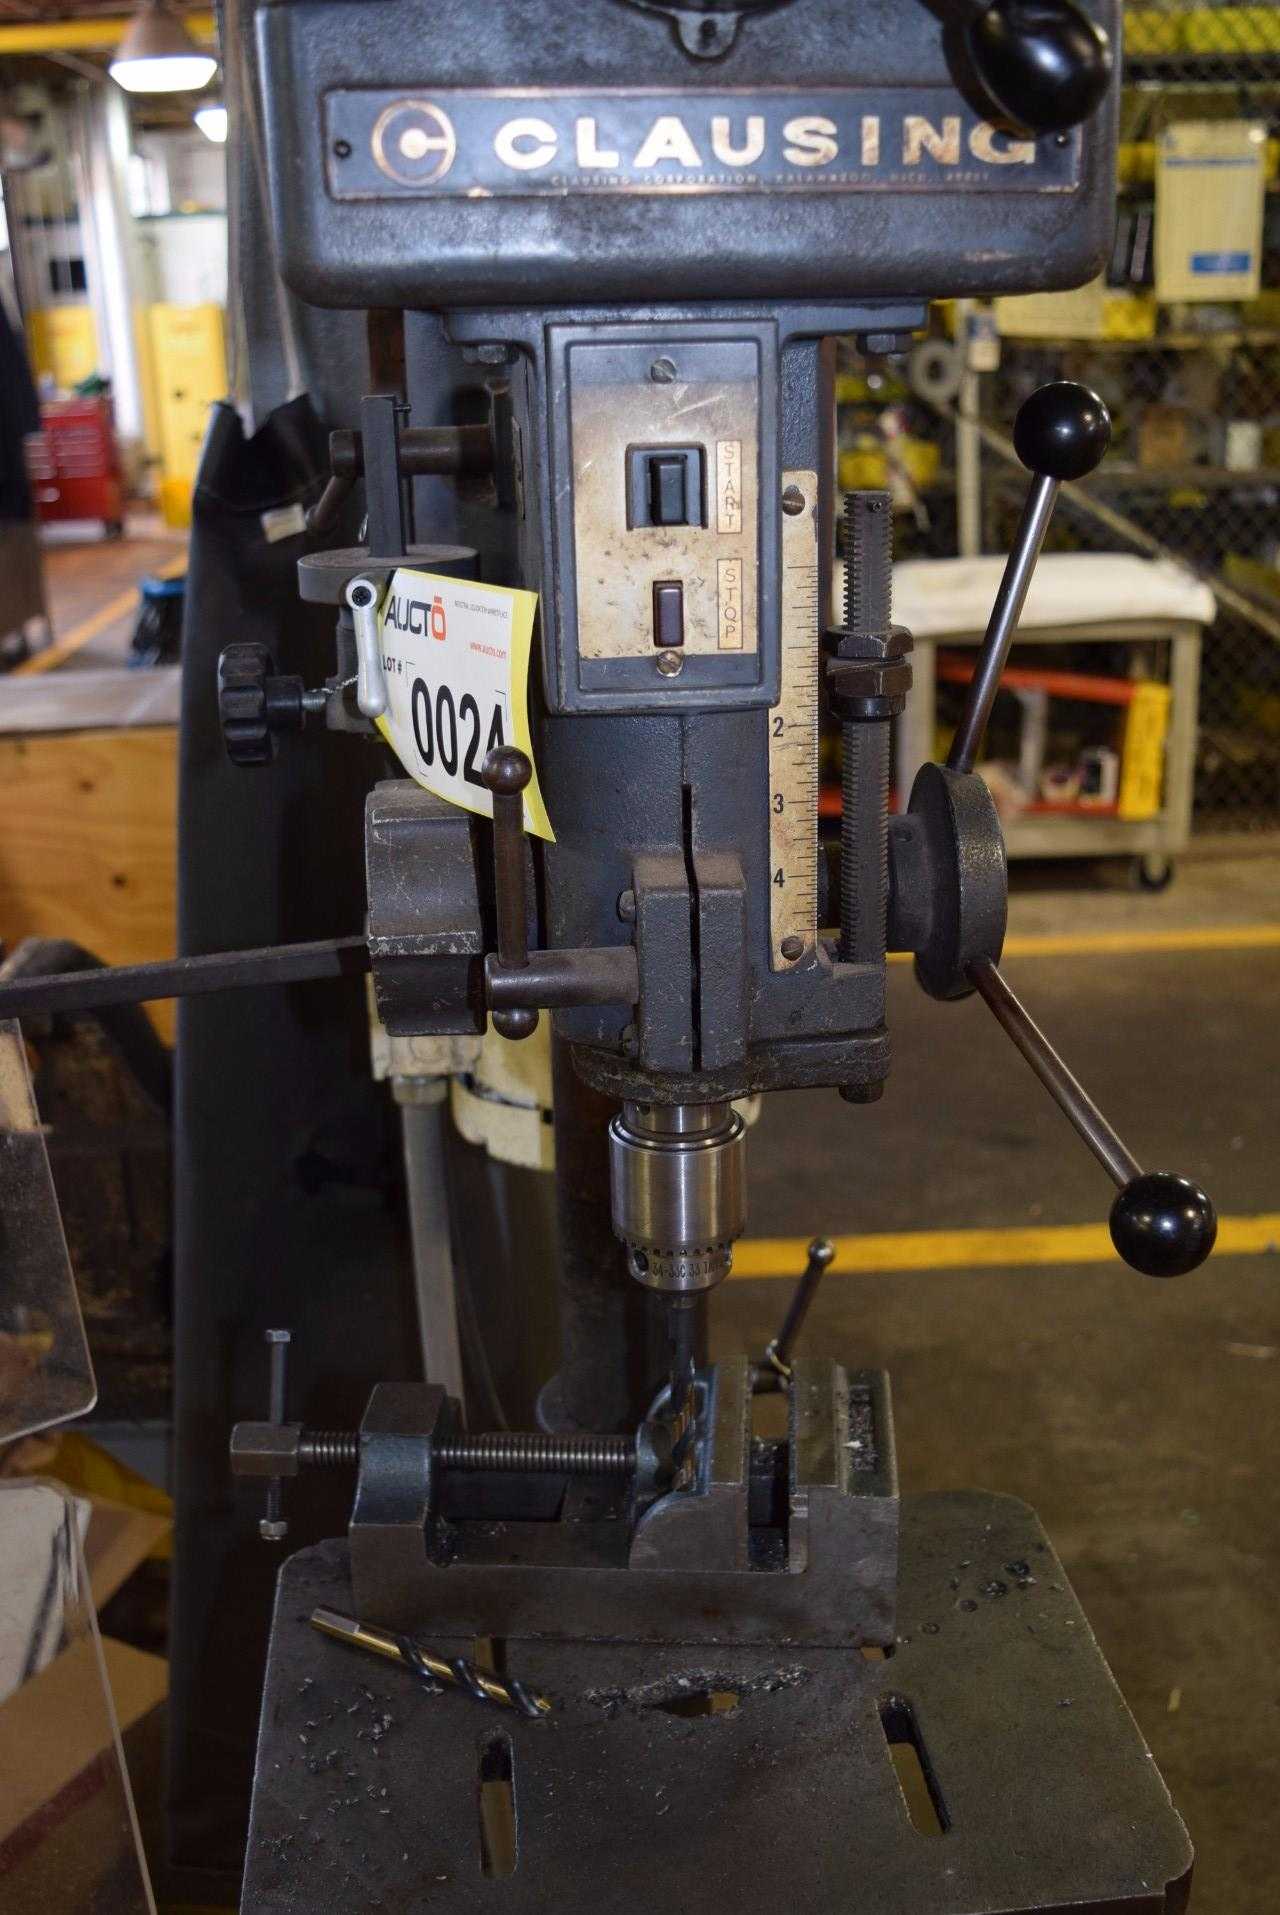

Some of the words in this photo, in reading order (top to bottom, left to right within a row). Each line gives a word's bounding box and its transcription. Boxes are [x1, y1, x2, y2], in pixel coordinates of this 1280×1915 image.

[494, 115, 1036, 170] CLAUSING
[722, 444, 737, 529] START
[723, 567, 738, 640] STOP
[382, 654, 396, 673] LOT
[772, 716, 785, 738] 2
[772, 793, 785, 814] 3
[773, 868, 786, 888] 4
